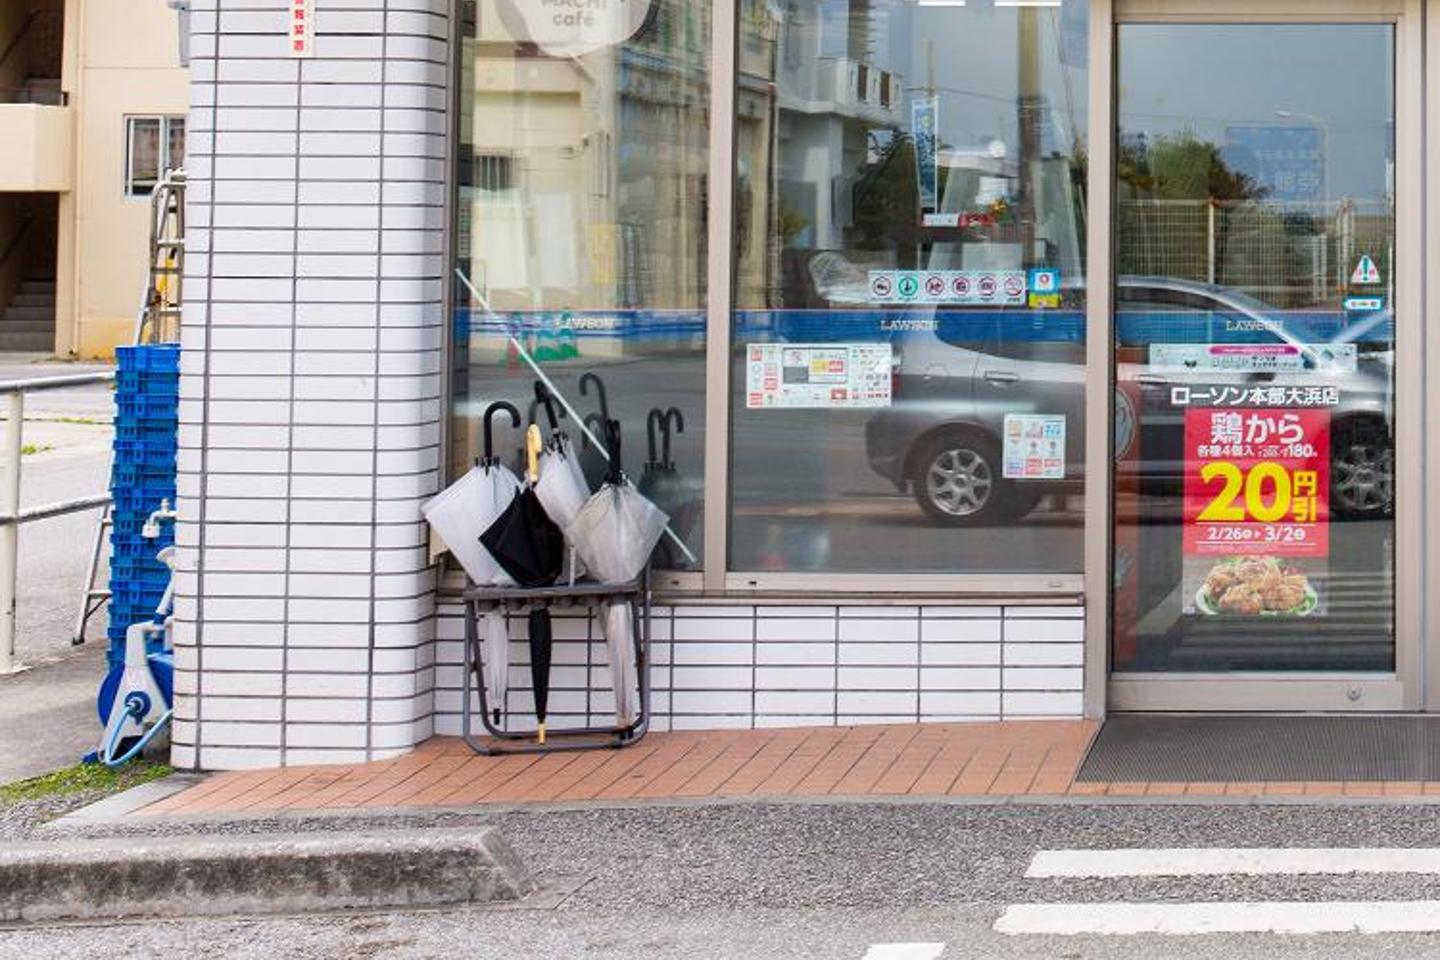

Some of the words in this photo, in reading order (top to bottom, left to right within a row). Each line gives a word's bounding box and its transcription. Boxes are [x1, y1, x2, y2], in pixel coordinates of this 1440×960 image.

[880, 319, 938, 331] LAWSON
[1171, 387, 1339, 406] ローソン本部大浜店
[1211, 412, 1304, 445] 鶏から
